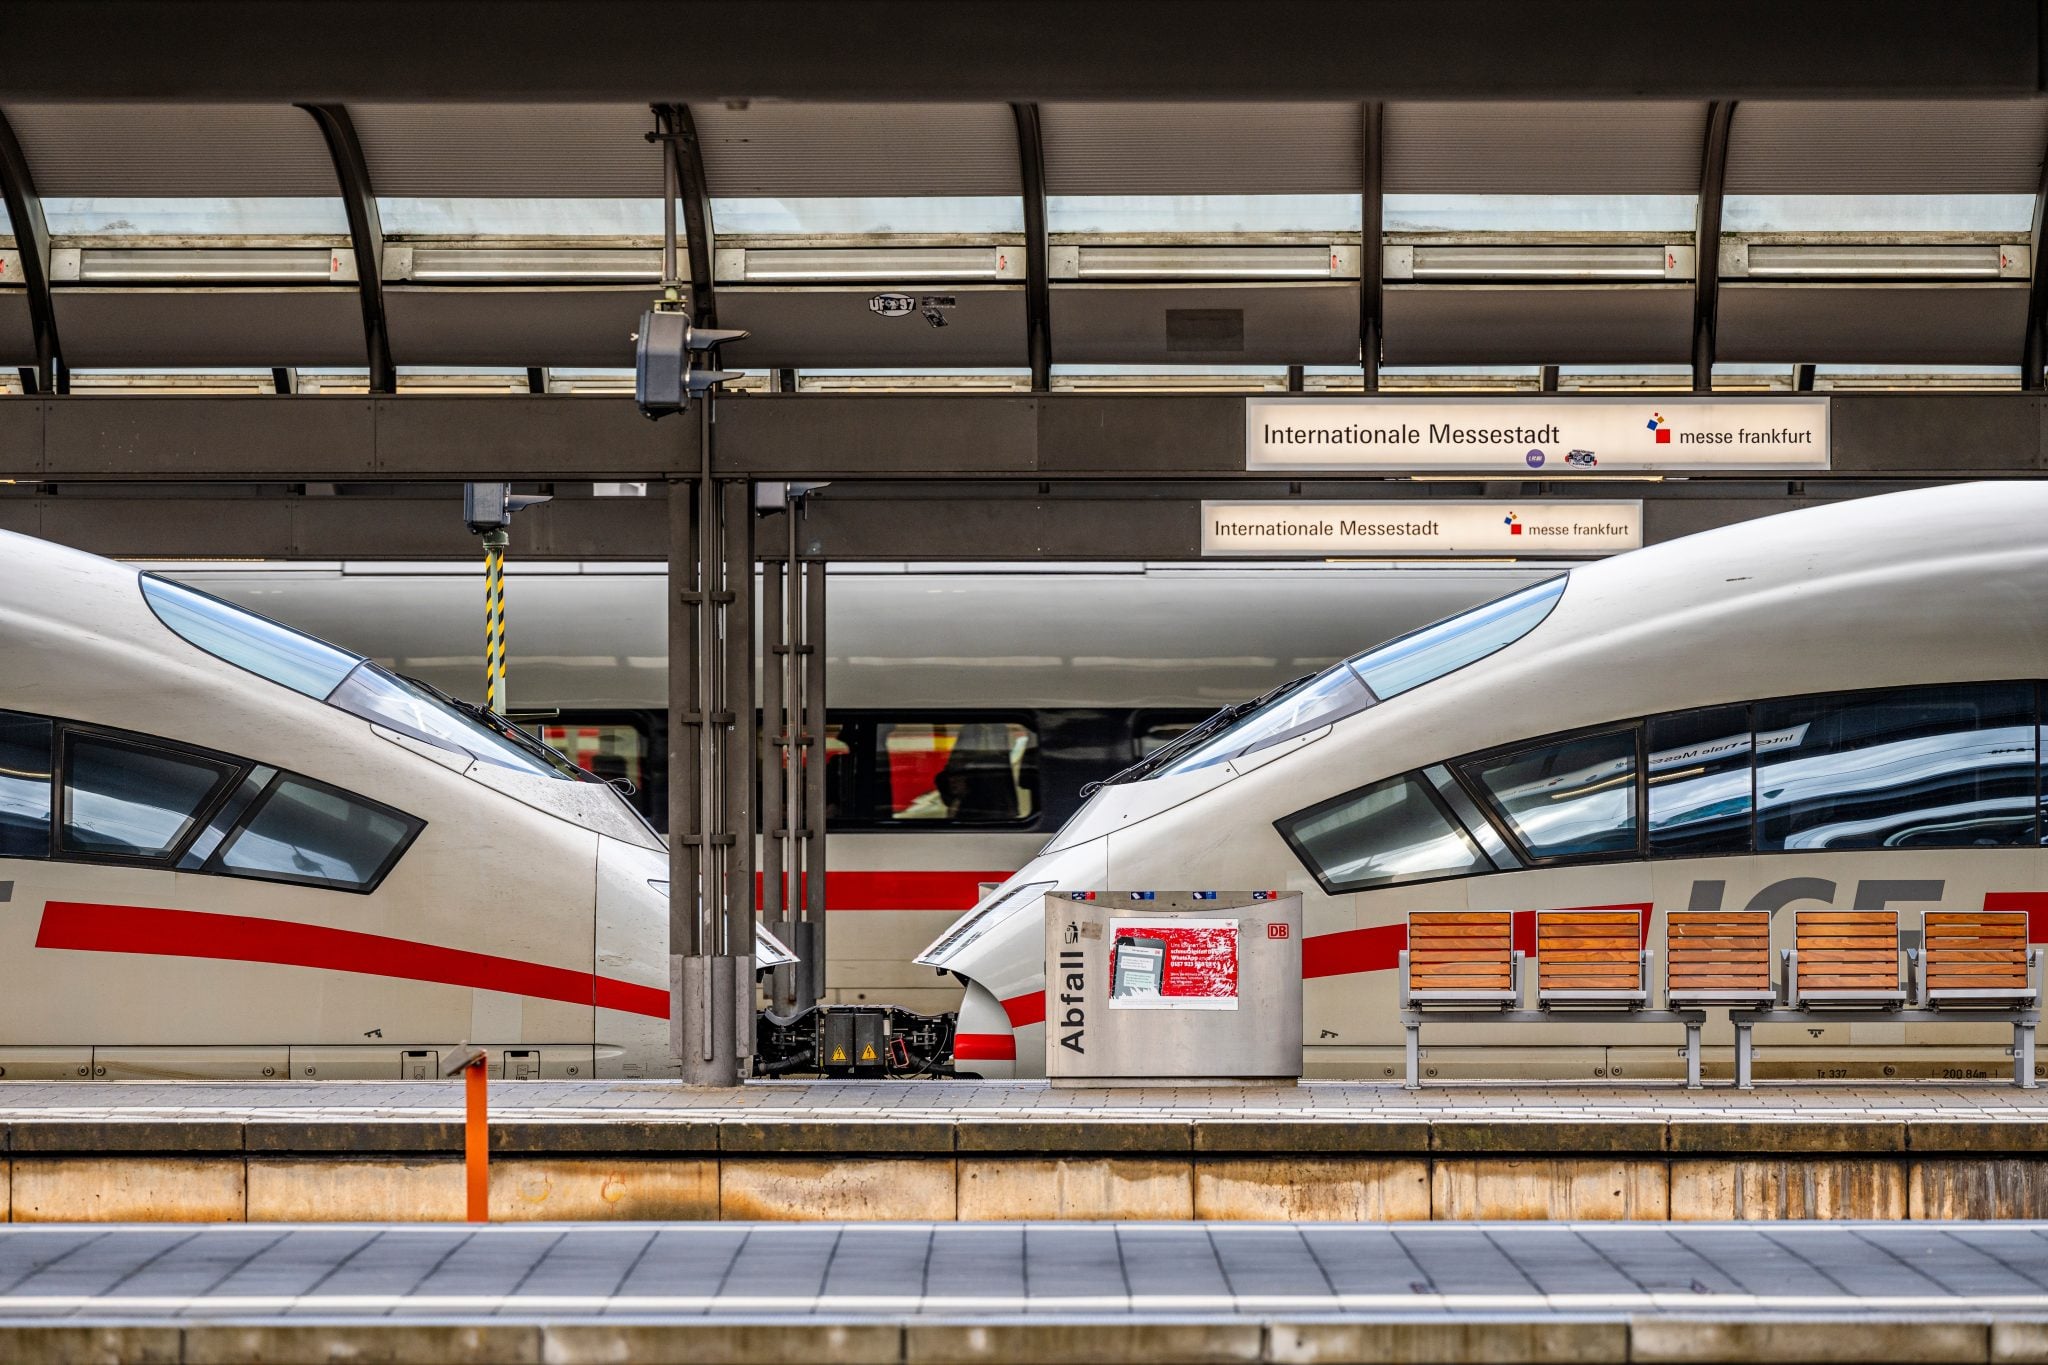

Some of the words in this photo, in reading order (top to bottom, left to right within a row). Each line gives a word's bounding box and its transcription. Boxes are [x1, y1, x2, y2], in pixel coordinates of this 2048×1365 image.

[1264, 424, 1420, 444] Internationale
[1429, 424, 1560, 444] Messestadt
[1679, 432, 1733, 444] messe
[1738, 428, 1812, 444] frankfurt
[1215, 520, 1334, 536] Internationale
[1340, 520, 1439, 536] Messestadt
[1529, 525, 1569, 535] messe
[1573, 523, 1629, 535] frankfurt
[1269, 924, 1288, 938] DB
[1060, 951, 1085, 1054] Abfall
[1829, 1070, 1847, 1079] 337
